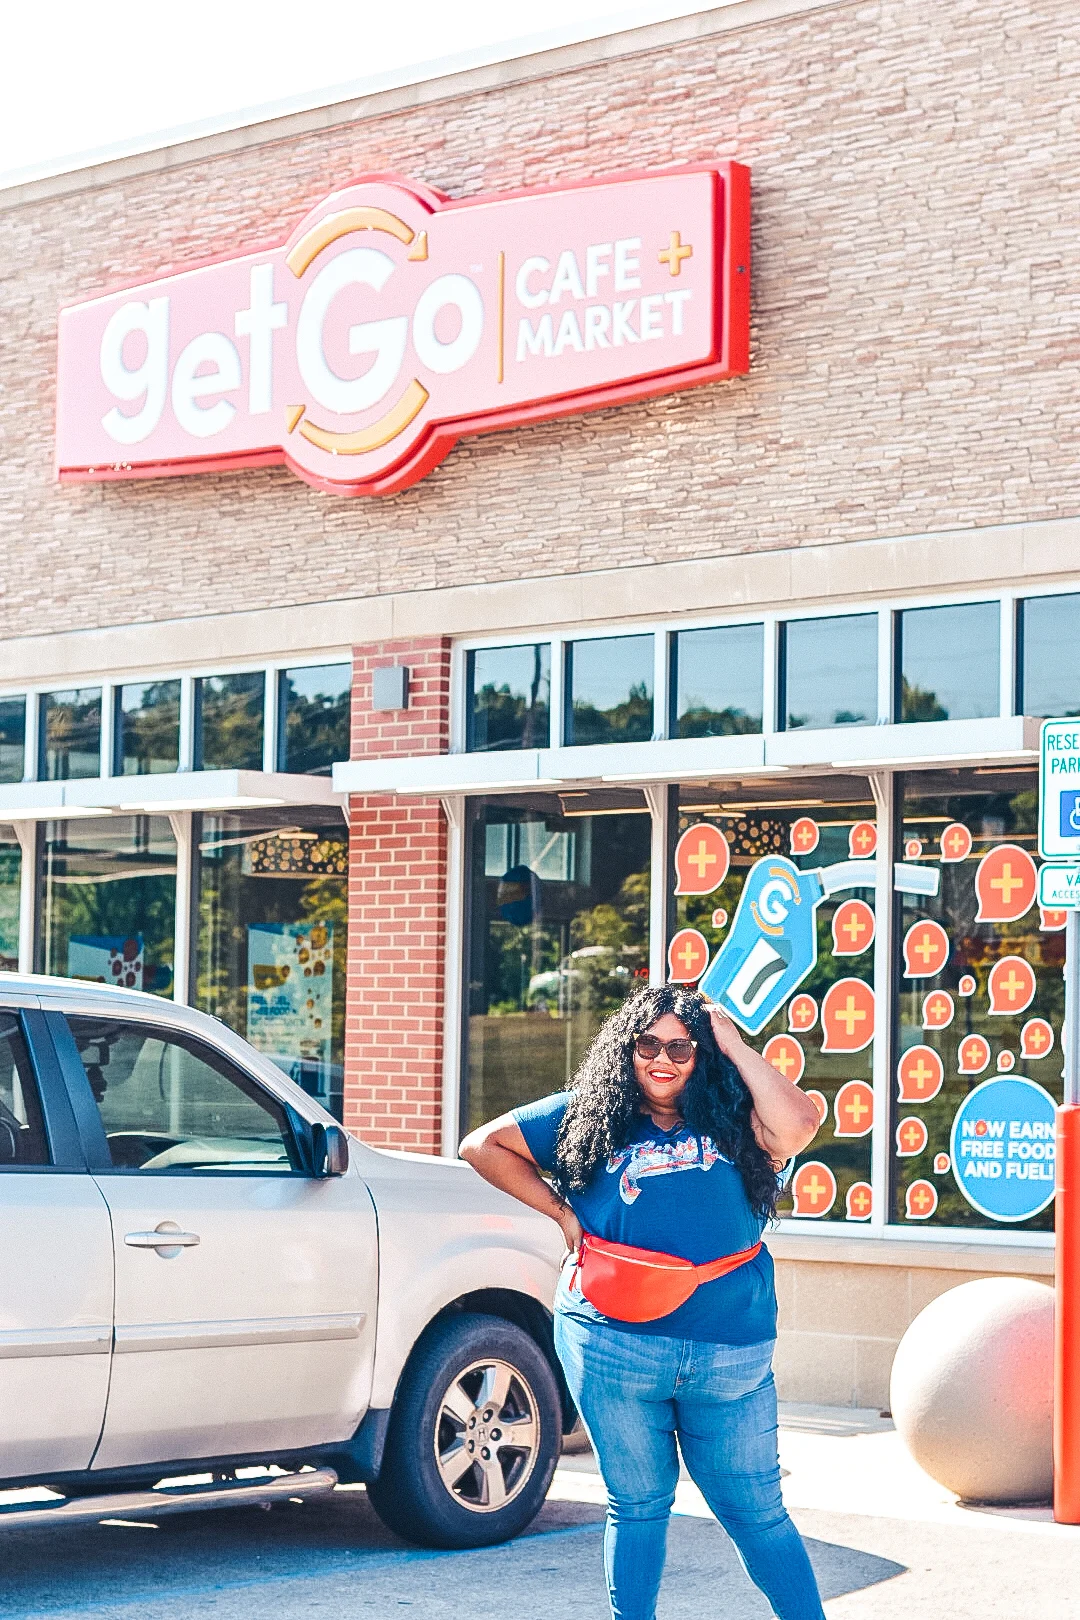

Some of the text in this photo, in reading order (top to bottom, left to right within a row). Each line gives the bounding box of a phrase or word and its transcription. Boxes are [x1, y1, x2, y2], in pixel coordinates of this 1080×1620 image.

[515, 236, 642, 309] CAFE
[101, 246, 484, 444] getGo
[515, 288, 692, 362] MARKET
[961, 1120, 1056, 1140] NOW EARN
[961, 1141, 1056, 1160] FREE FOOD
[963, 1160, 1003, 1178] AND
